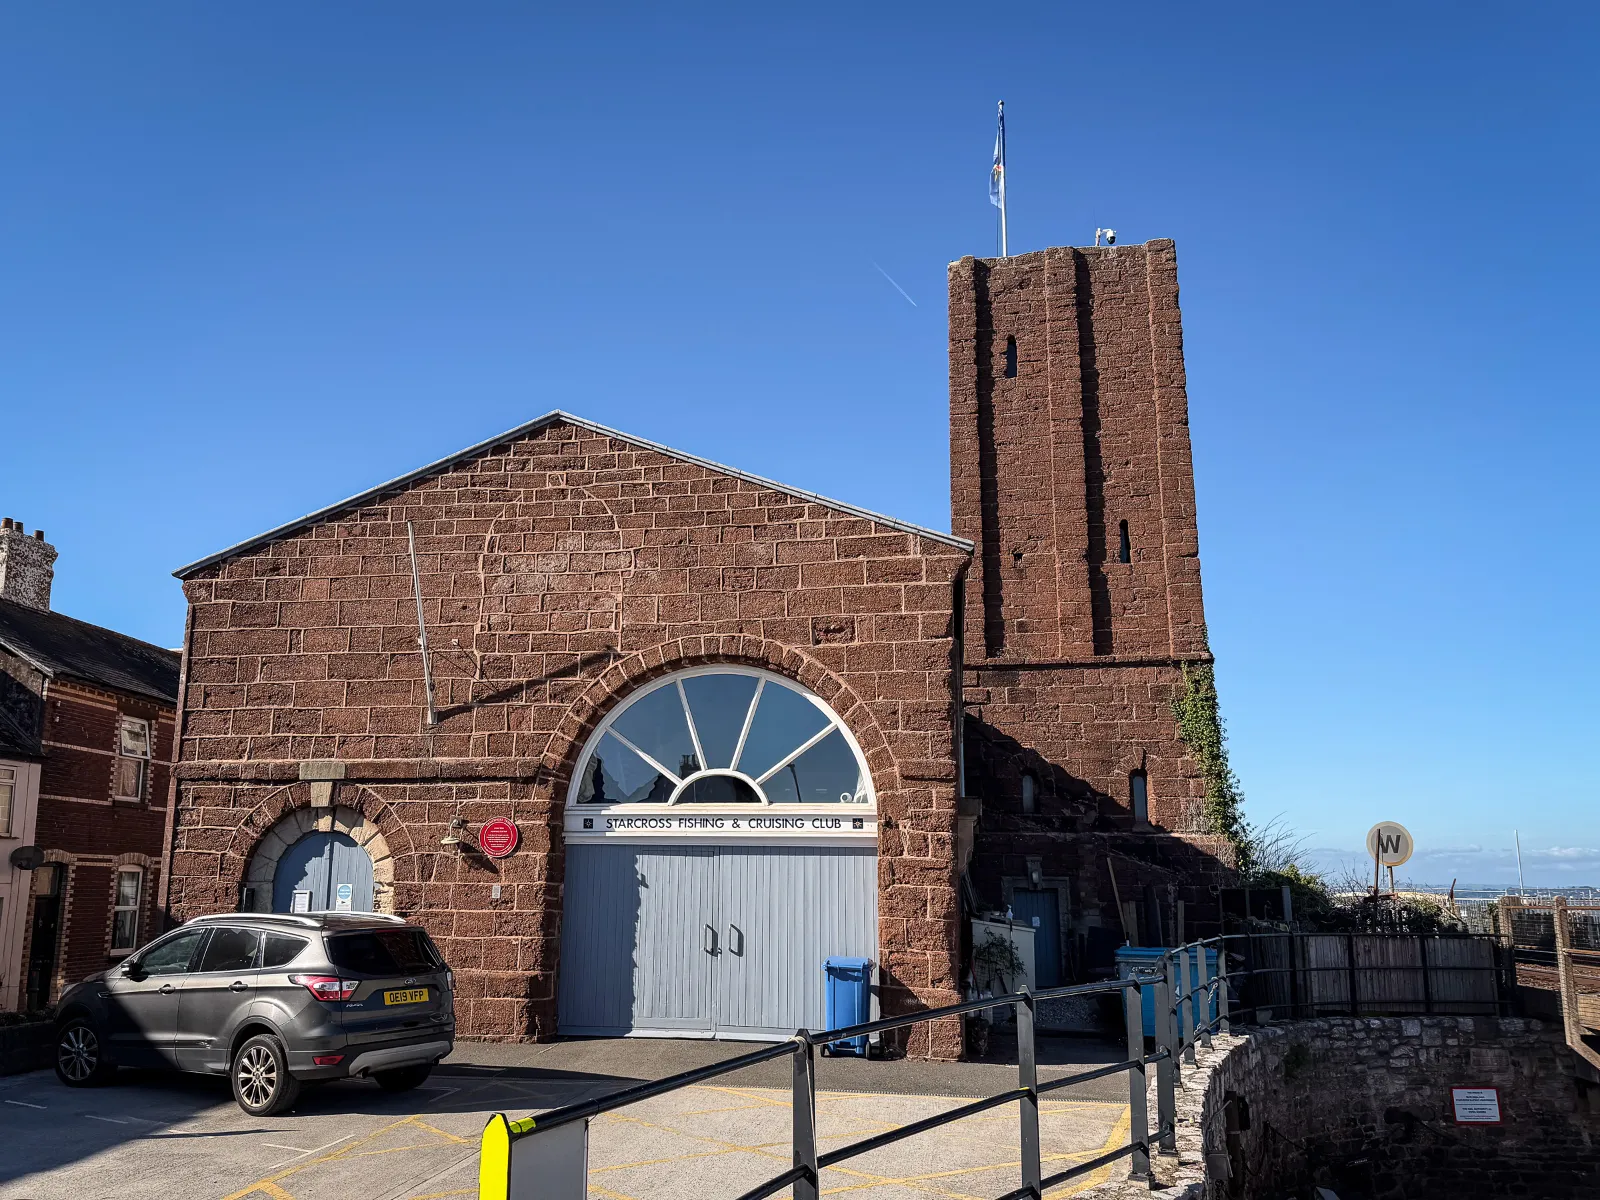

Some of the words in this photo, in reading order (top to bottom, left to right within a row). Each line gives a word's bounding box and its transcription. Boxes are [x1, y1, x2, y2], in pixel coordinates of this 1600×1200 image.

[605, 817, 672, 829] STARCROSS
[679, 817, 724, 829] FISHING
[732, 817, 740, 829] &
[748, 817, 804, 829] CRUISING
[811, 817, 841, 829] CLUB
[1378, 835, 1401, 853] W
[389, 993, 407, 1003] OE19
[409, 991, 424, 1000] VFP
